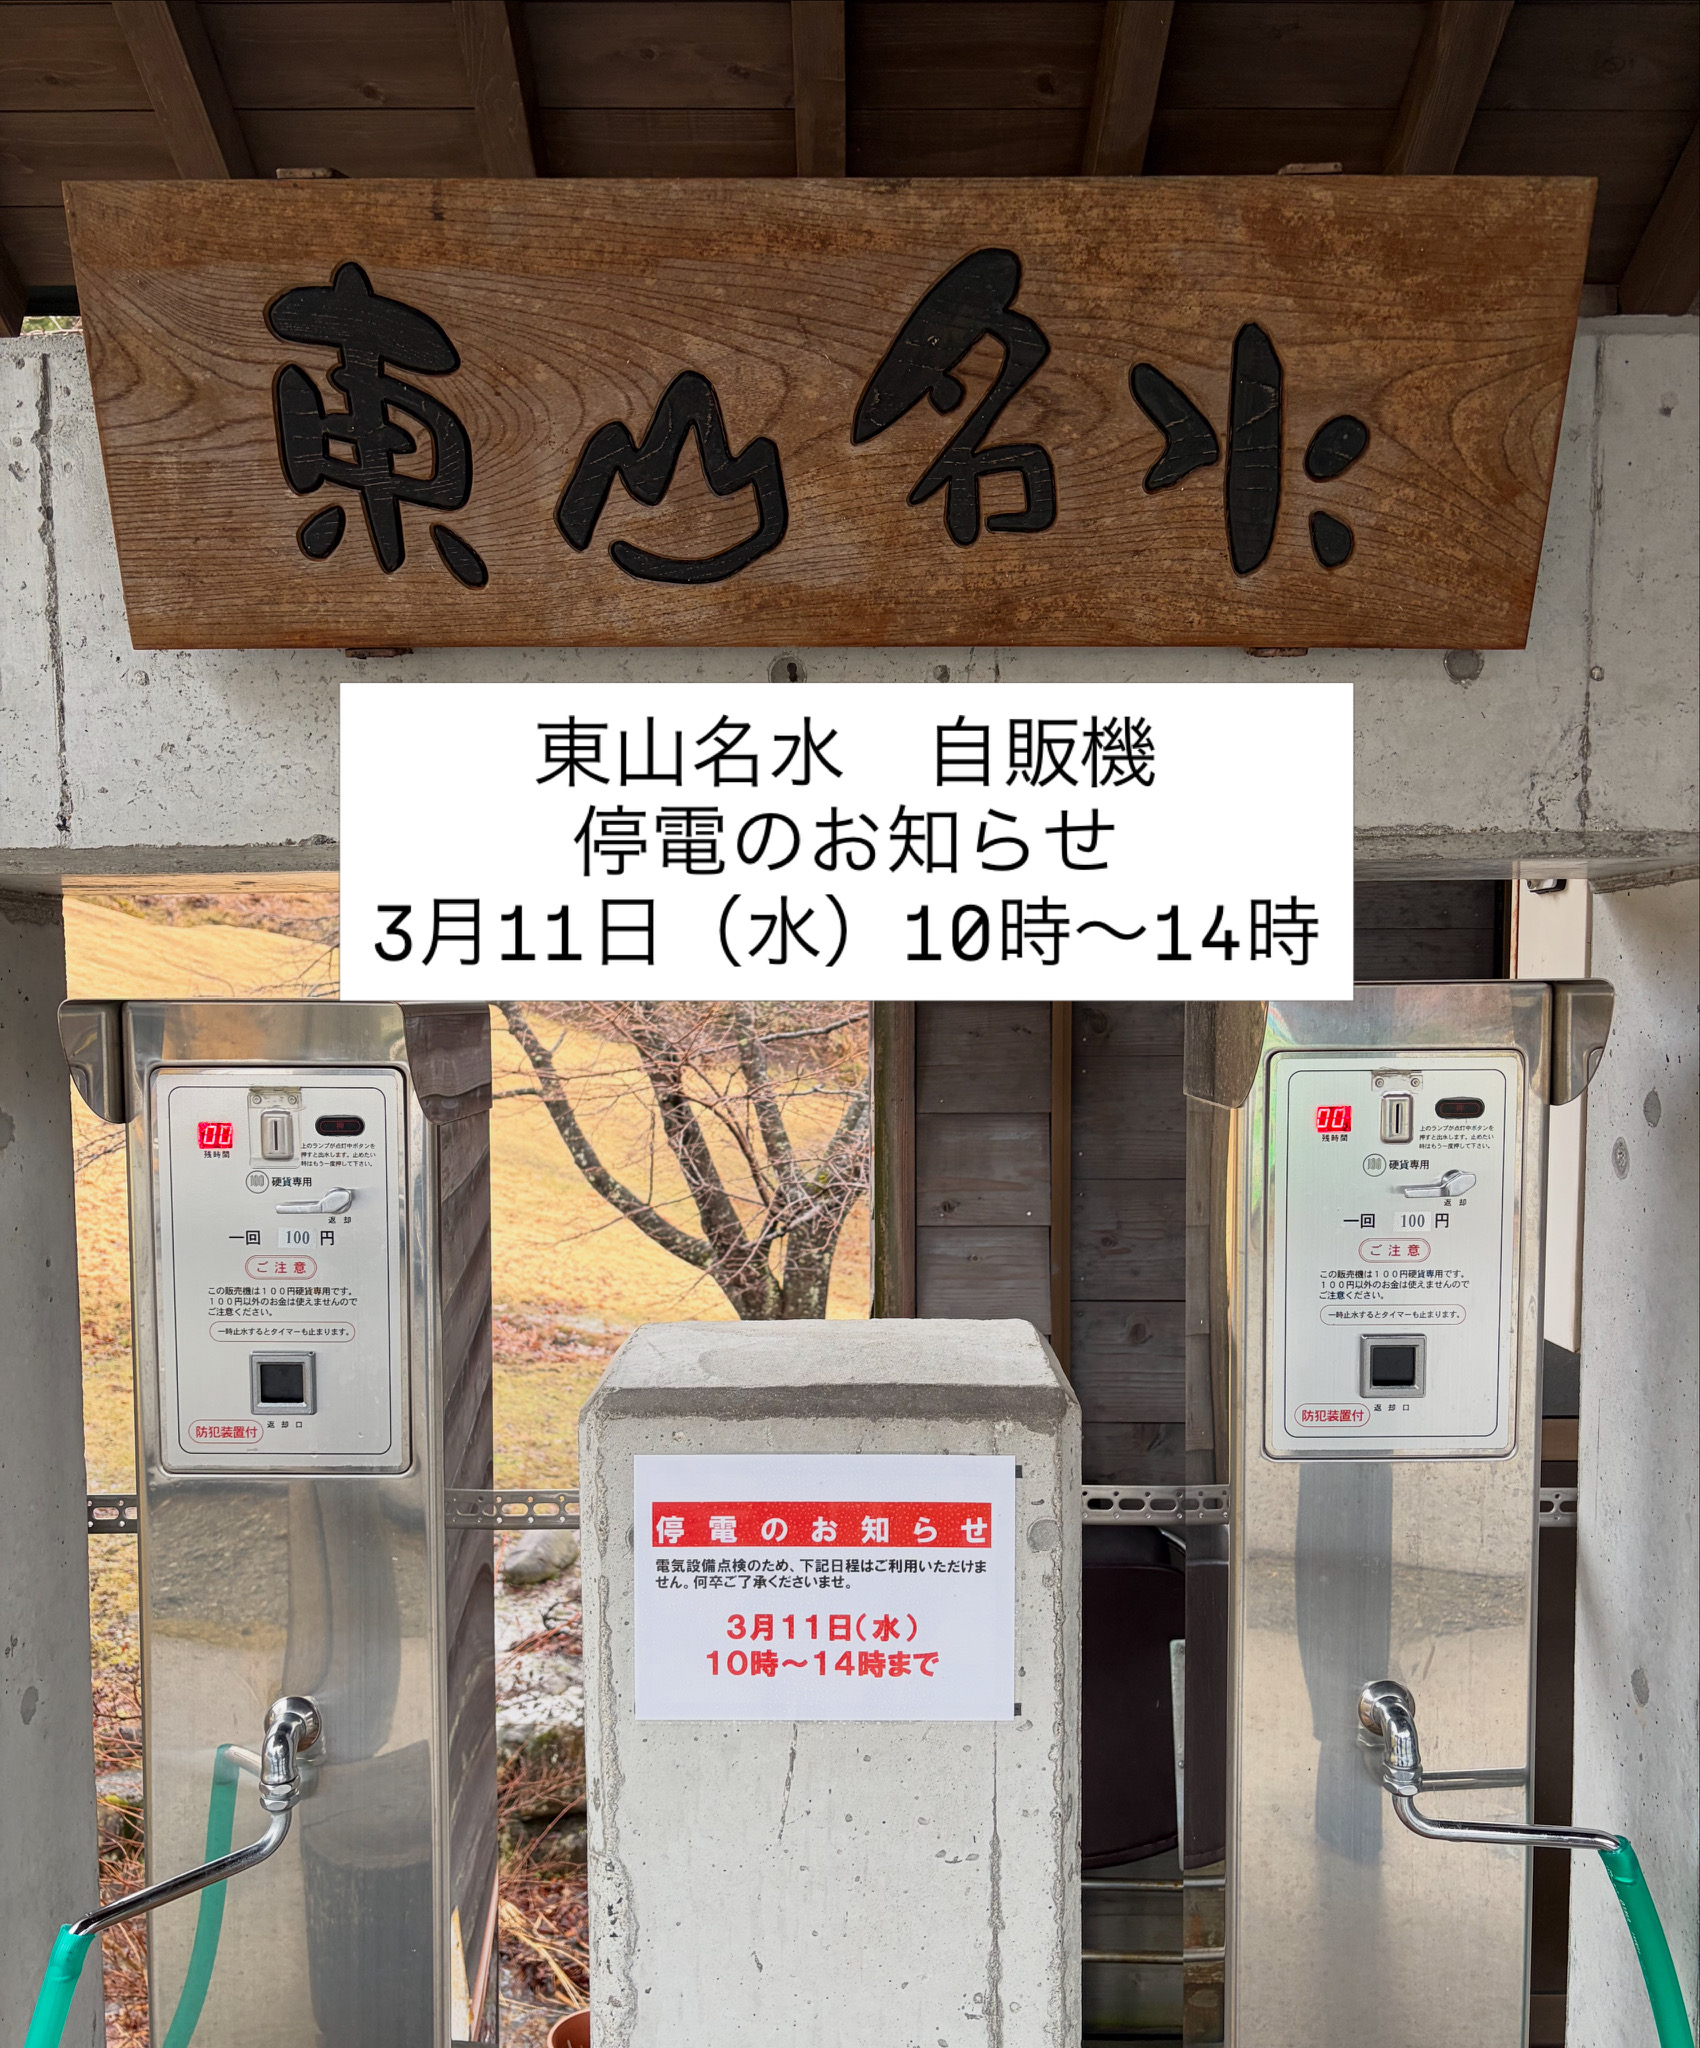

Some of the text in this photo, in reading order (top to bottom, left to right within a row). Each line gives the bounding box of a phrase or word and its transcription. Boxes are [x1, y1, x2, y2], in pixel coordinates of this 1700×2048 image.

[263, 246, 1370, 588] 東山名水
[1322, 1134, 1348, 1143] 残時間
[204, 1151, 231, 1159] 残時間
[1389, 1160, 1430, 1171] 硬貨専用
[272, 1177, 313, 1188] 硬貨専用
[1344, 1213, 1450, 1229] 一回 100 円
[229, 1231, 335, 1246] 一回 100 円
[1371, 1245, 1420, 1257] ご注意
[257, 1261, 307, 1274] ご注意
[1320, 1270, 1464, 1279] この販売機は100円硬貨専用です。
[1322, 1280, 1470, 1290] 100円以外のお金は使えませんので
[209, 1287, 352, 1296] この販売機は100円硬貨専用です。
[1320, 1291, 1384, 1300] ご注意ください。
[211, 1297, 358, 1307] 100円以外のお金は使えませんので
[208, 1308, 273, 1317] ご注意ください。
[1328, 1311, 1460, 1319] 一時止水するとタイマーも止まります。
[218, 1328, 350, 1336] 一時止水するとタイマーも止まります。
[1374, 1404, 1410, 1412] 返却口
[1302, 1410, 1365, 1423] 防犯装置付
[267, 1421, 303, 1429] 返却口
[195, 1426, 258, 1439] 防犯装置付
[656, 1515, 988, 1544] 停電のお知らせ
[656, 1559, 987, 1574] 電気設備点検のため、下記日程はご利用いただけま
[656, 1575, 851, 1590] せん。何卒ご了承くださいませ。
[727, 1613, 918, 1643] 3月11日（水）
